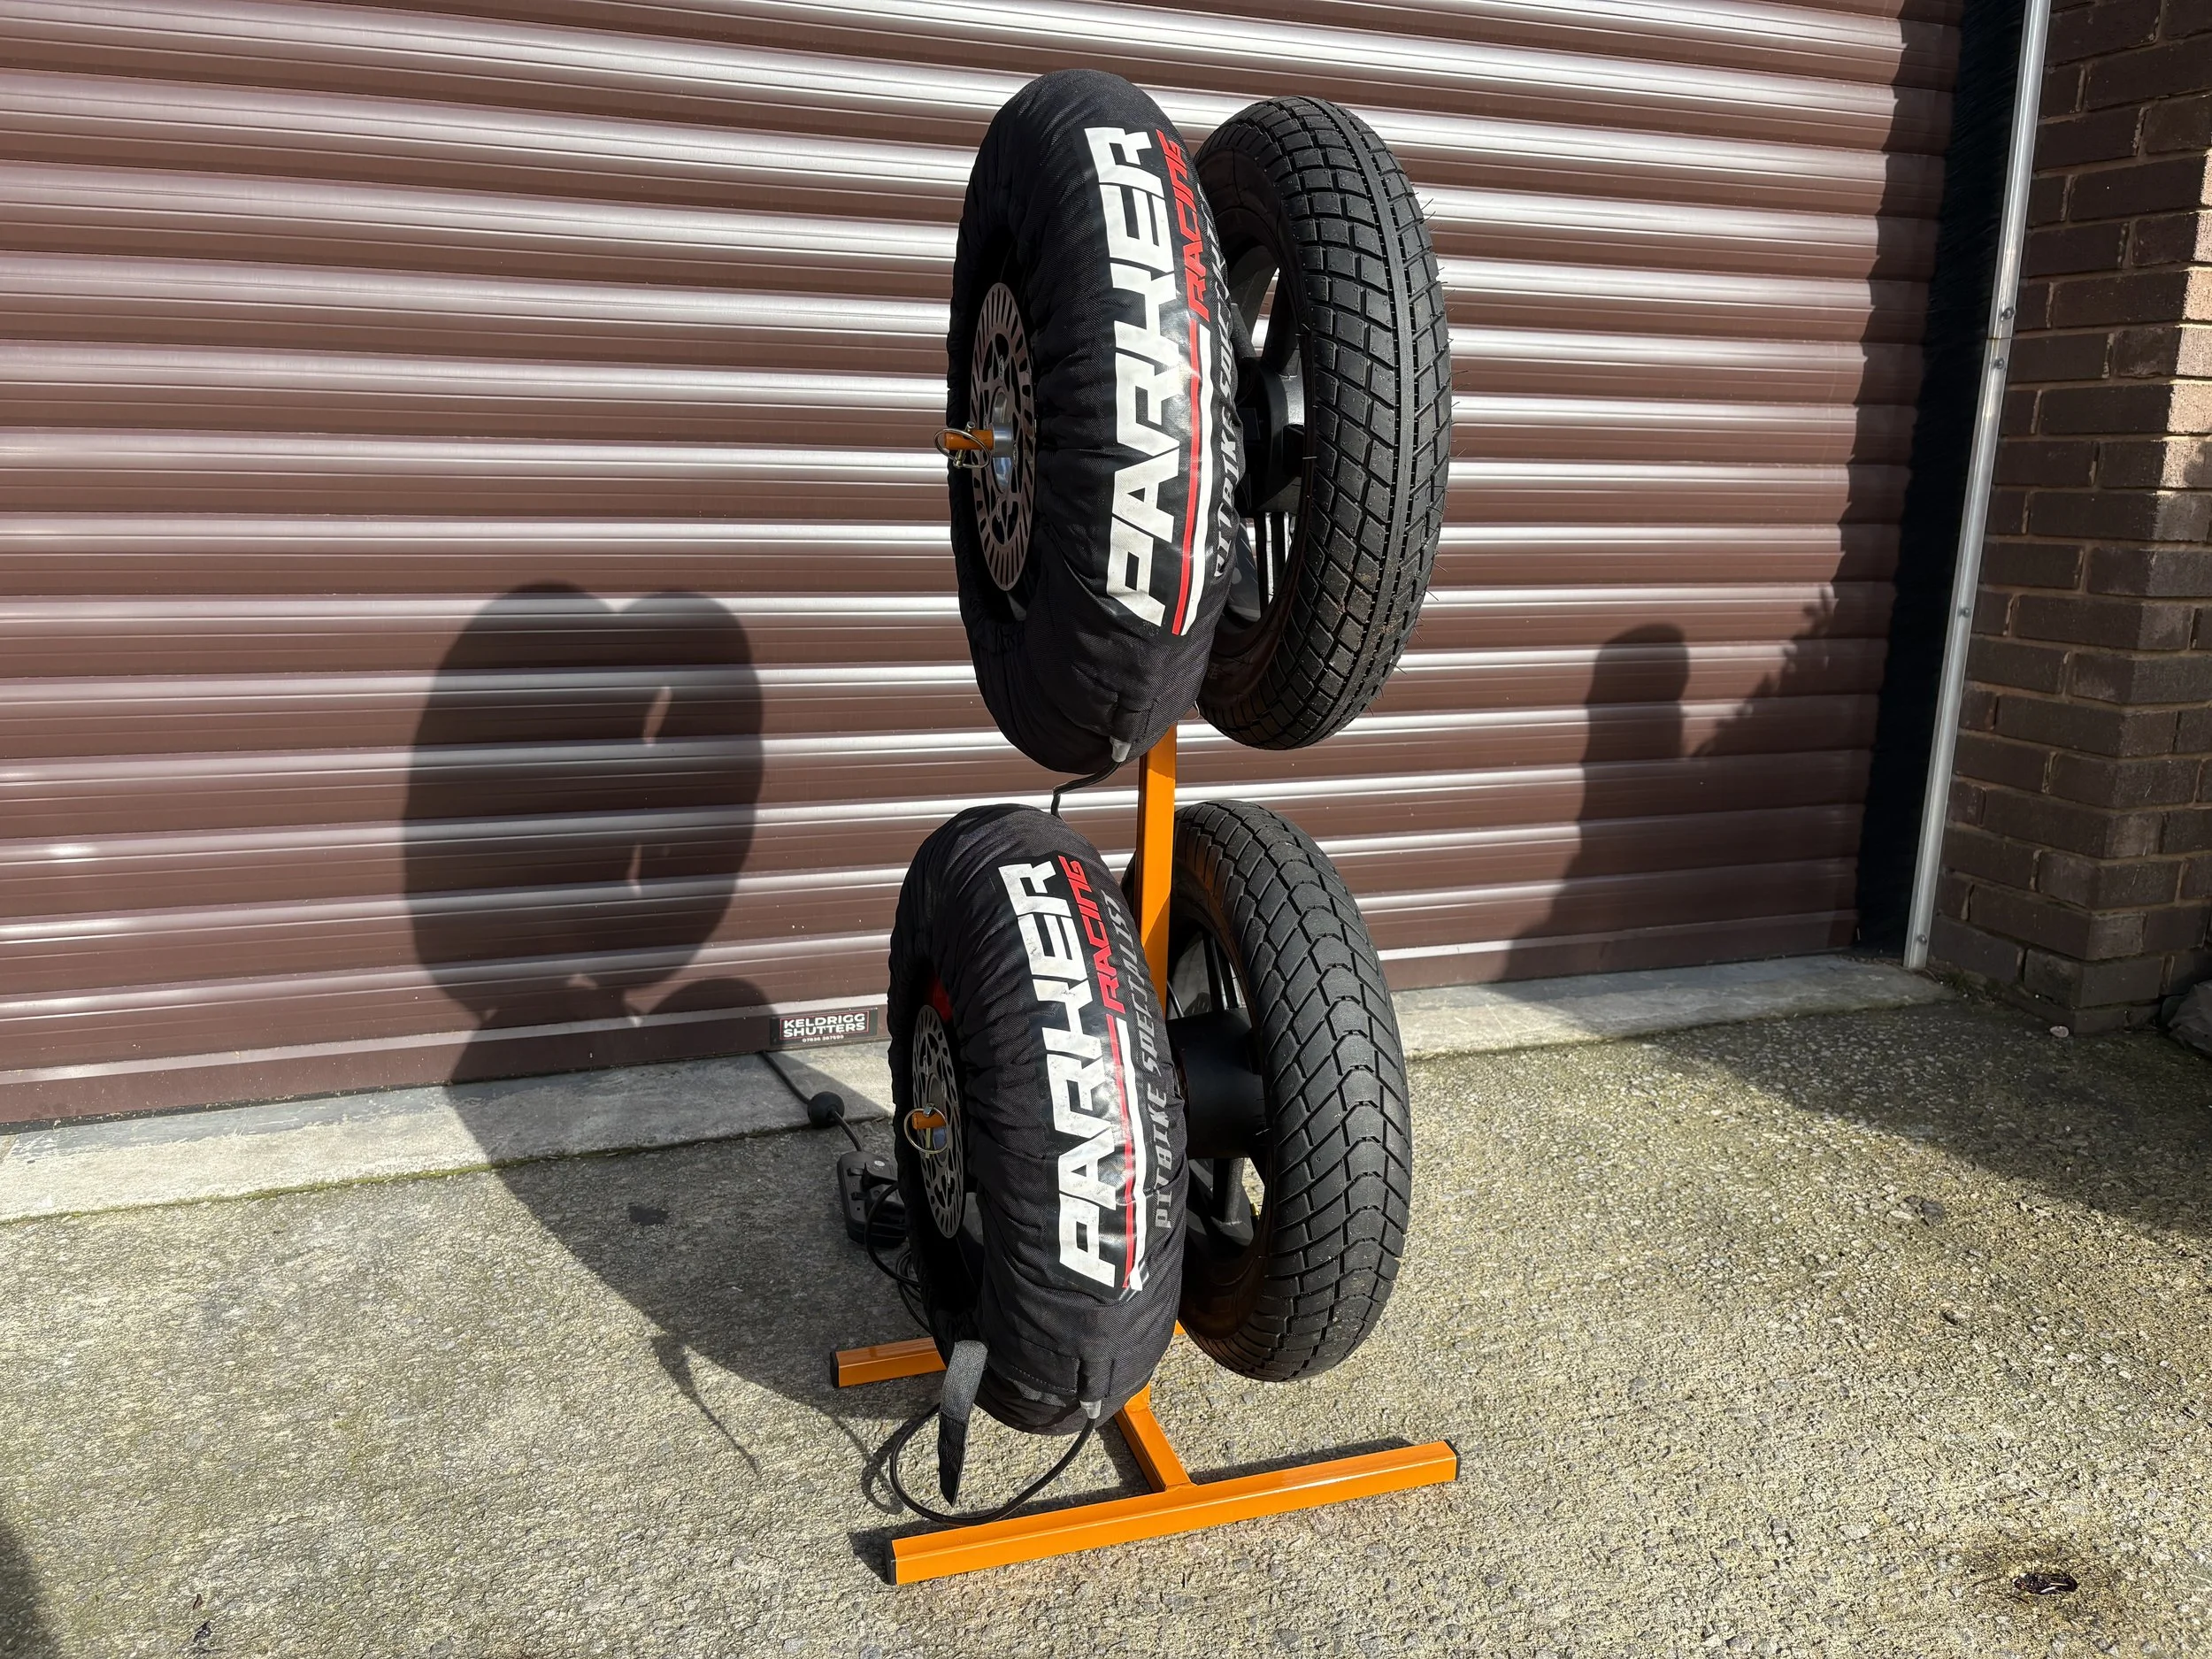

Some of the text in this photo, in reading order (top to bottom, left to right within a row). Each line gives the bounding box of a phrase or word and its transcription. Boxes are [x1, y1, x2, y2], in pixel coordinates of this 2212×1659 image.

[1156, 128, 1210, 322] RACING
[1084, 127, 1182, 626] PARKER
[784, 1013, 865, 1029] KELDRIGG
[1058, 856, 1125, 1015] RACING
[1101, 889, 1162, 1077] SPECIALIST
[783, 1022, 865, 1038] SHUTTERS
[998, 861, 1116, 1287] PARKER
